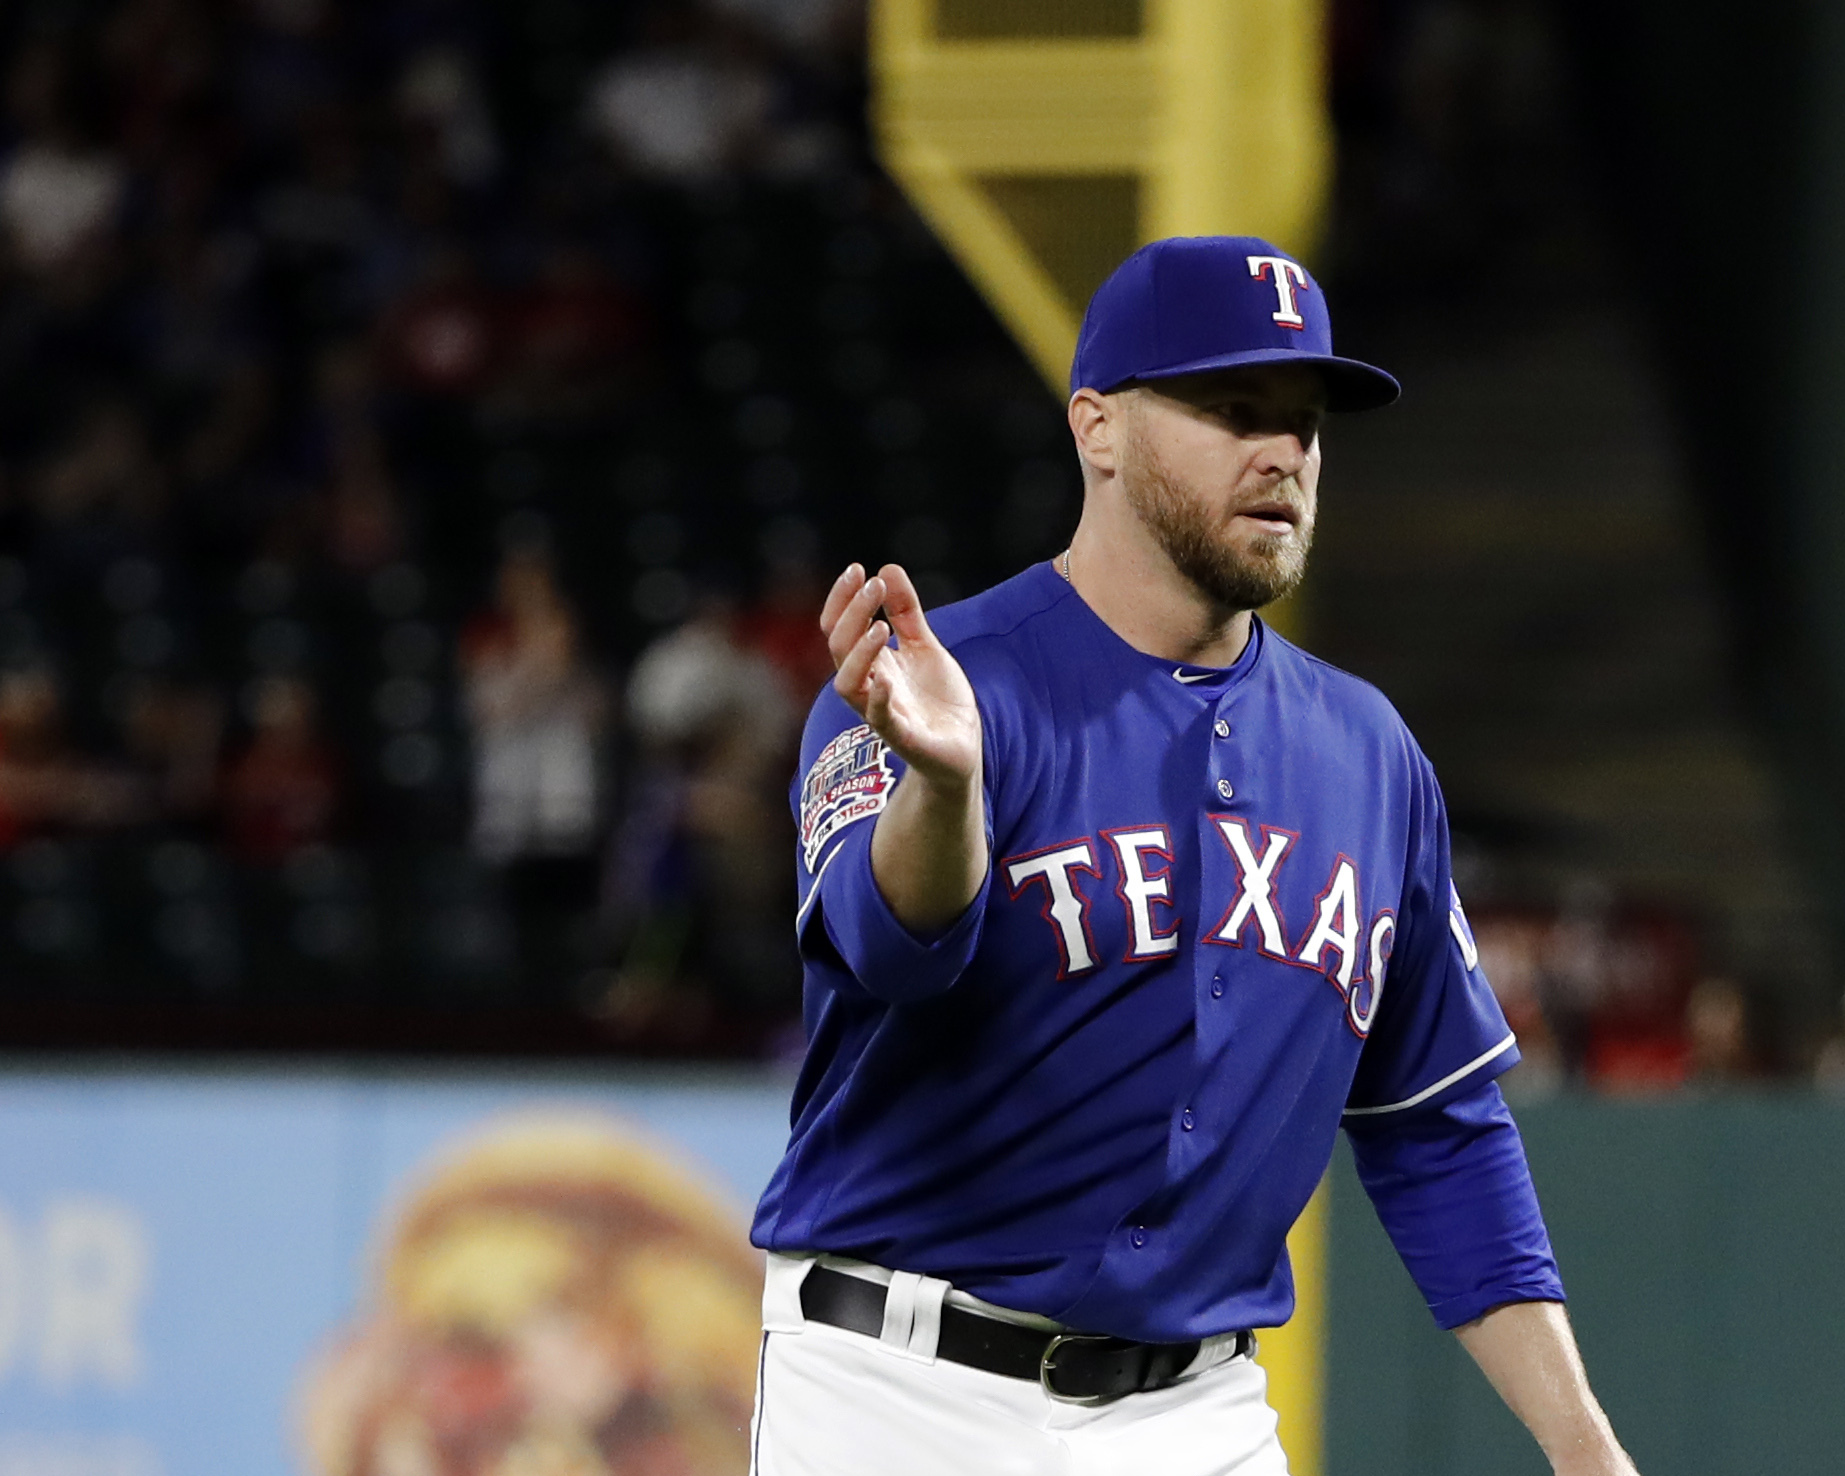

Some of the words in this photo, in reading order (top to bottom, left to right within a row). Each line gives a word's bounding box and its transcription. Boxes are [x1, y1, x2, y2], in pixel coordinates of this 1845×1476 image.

[1246, 255, 1308, 331] T
[829, 773, 877, 801] SEASON
[1001, 812, 1395, 1039] TEXAS
